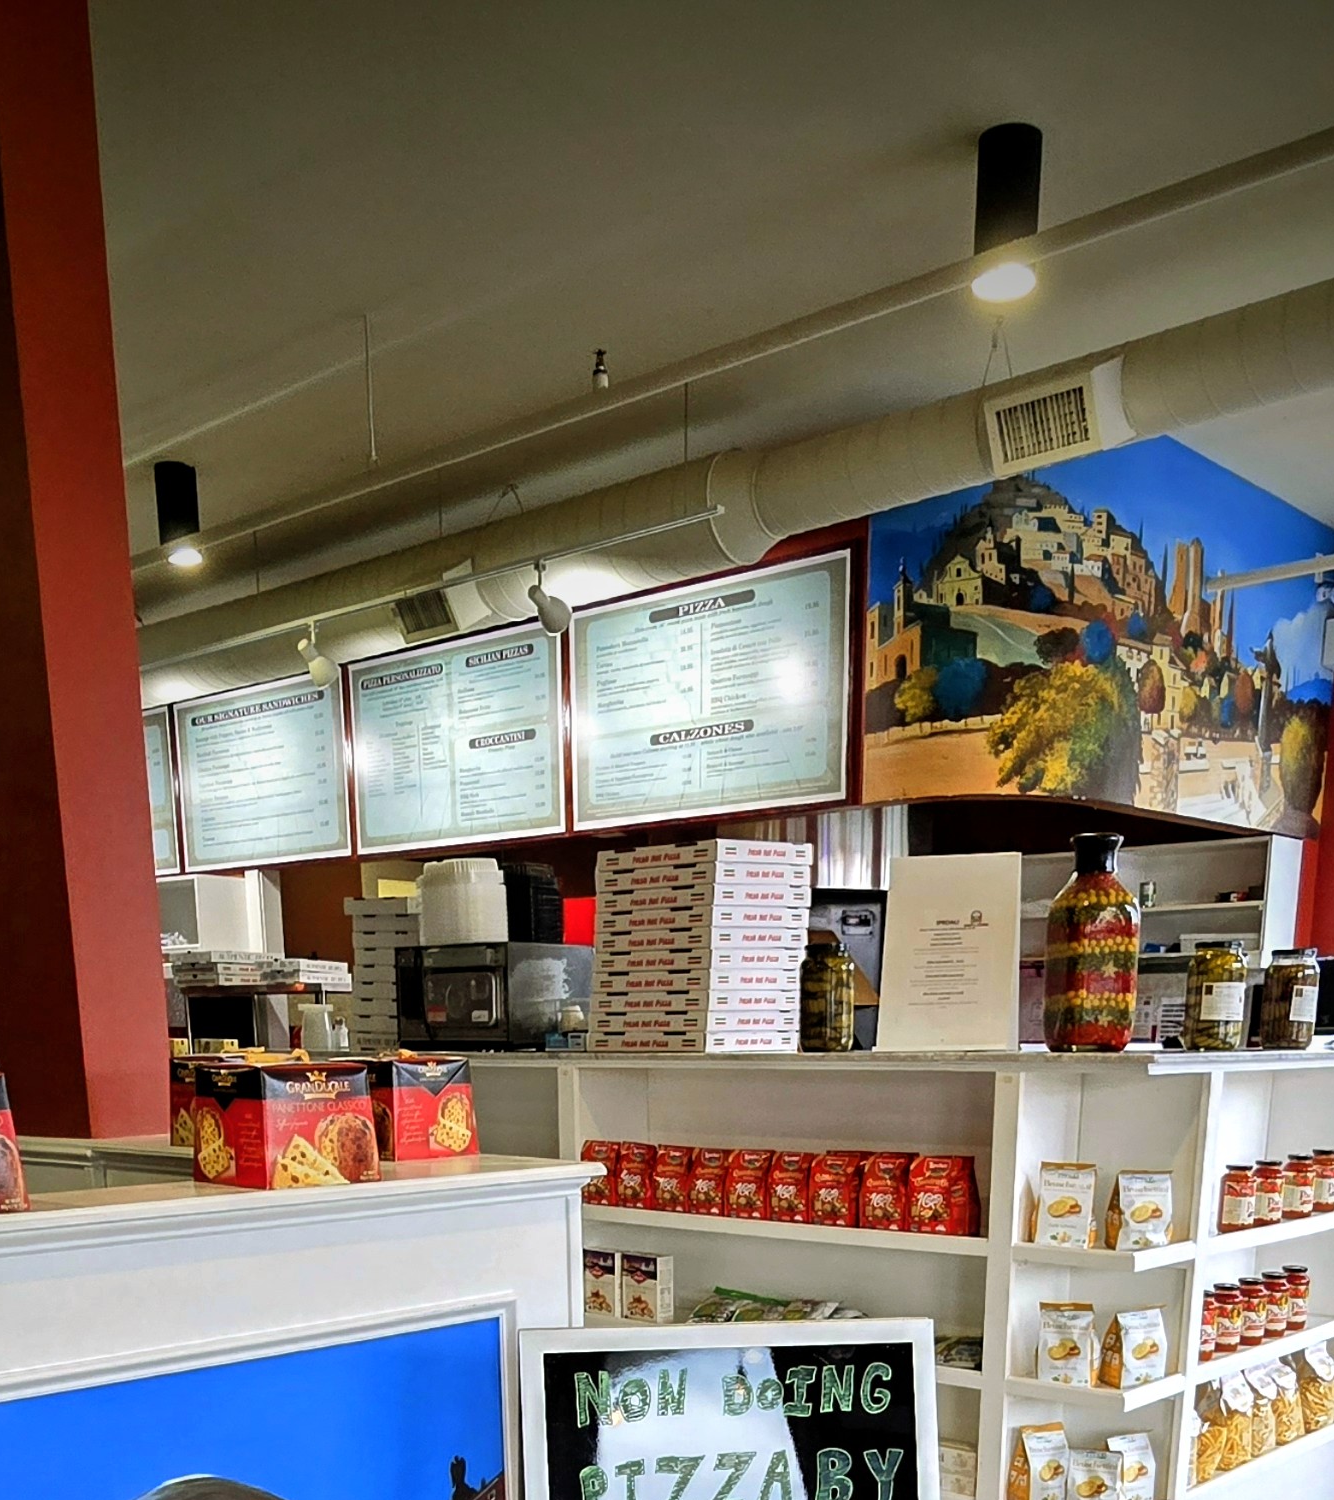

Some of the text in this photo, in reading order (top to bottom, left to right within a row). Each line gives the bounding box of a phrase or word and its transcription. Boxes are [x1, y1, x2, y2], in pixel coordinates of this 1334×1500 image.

[677, 597, 726, 617] PIZZA
[468, 645, 530, 667] SICILIAN PIZZAS
[363, 664, 442, 689] PIZZA PERSONALIZZATO
[195, 692, 320, 726] OUR SIGNATURE SANDWICHES
[475, 731, 526, 748] CROCCANTINI
[658, 720, 746, 745] CALZONES
[272, 1100, 366, 1113] PANETTONE CLASSICO
[575, 1367, 688, 1428] NOW
